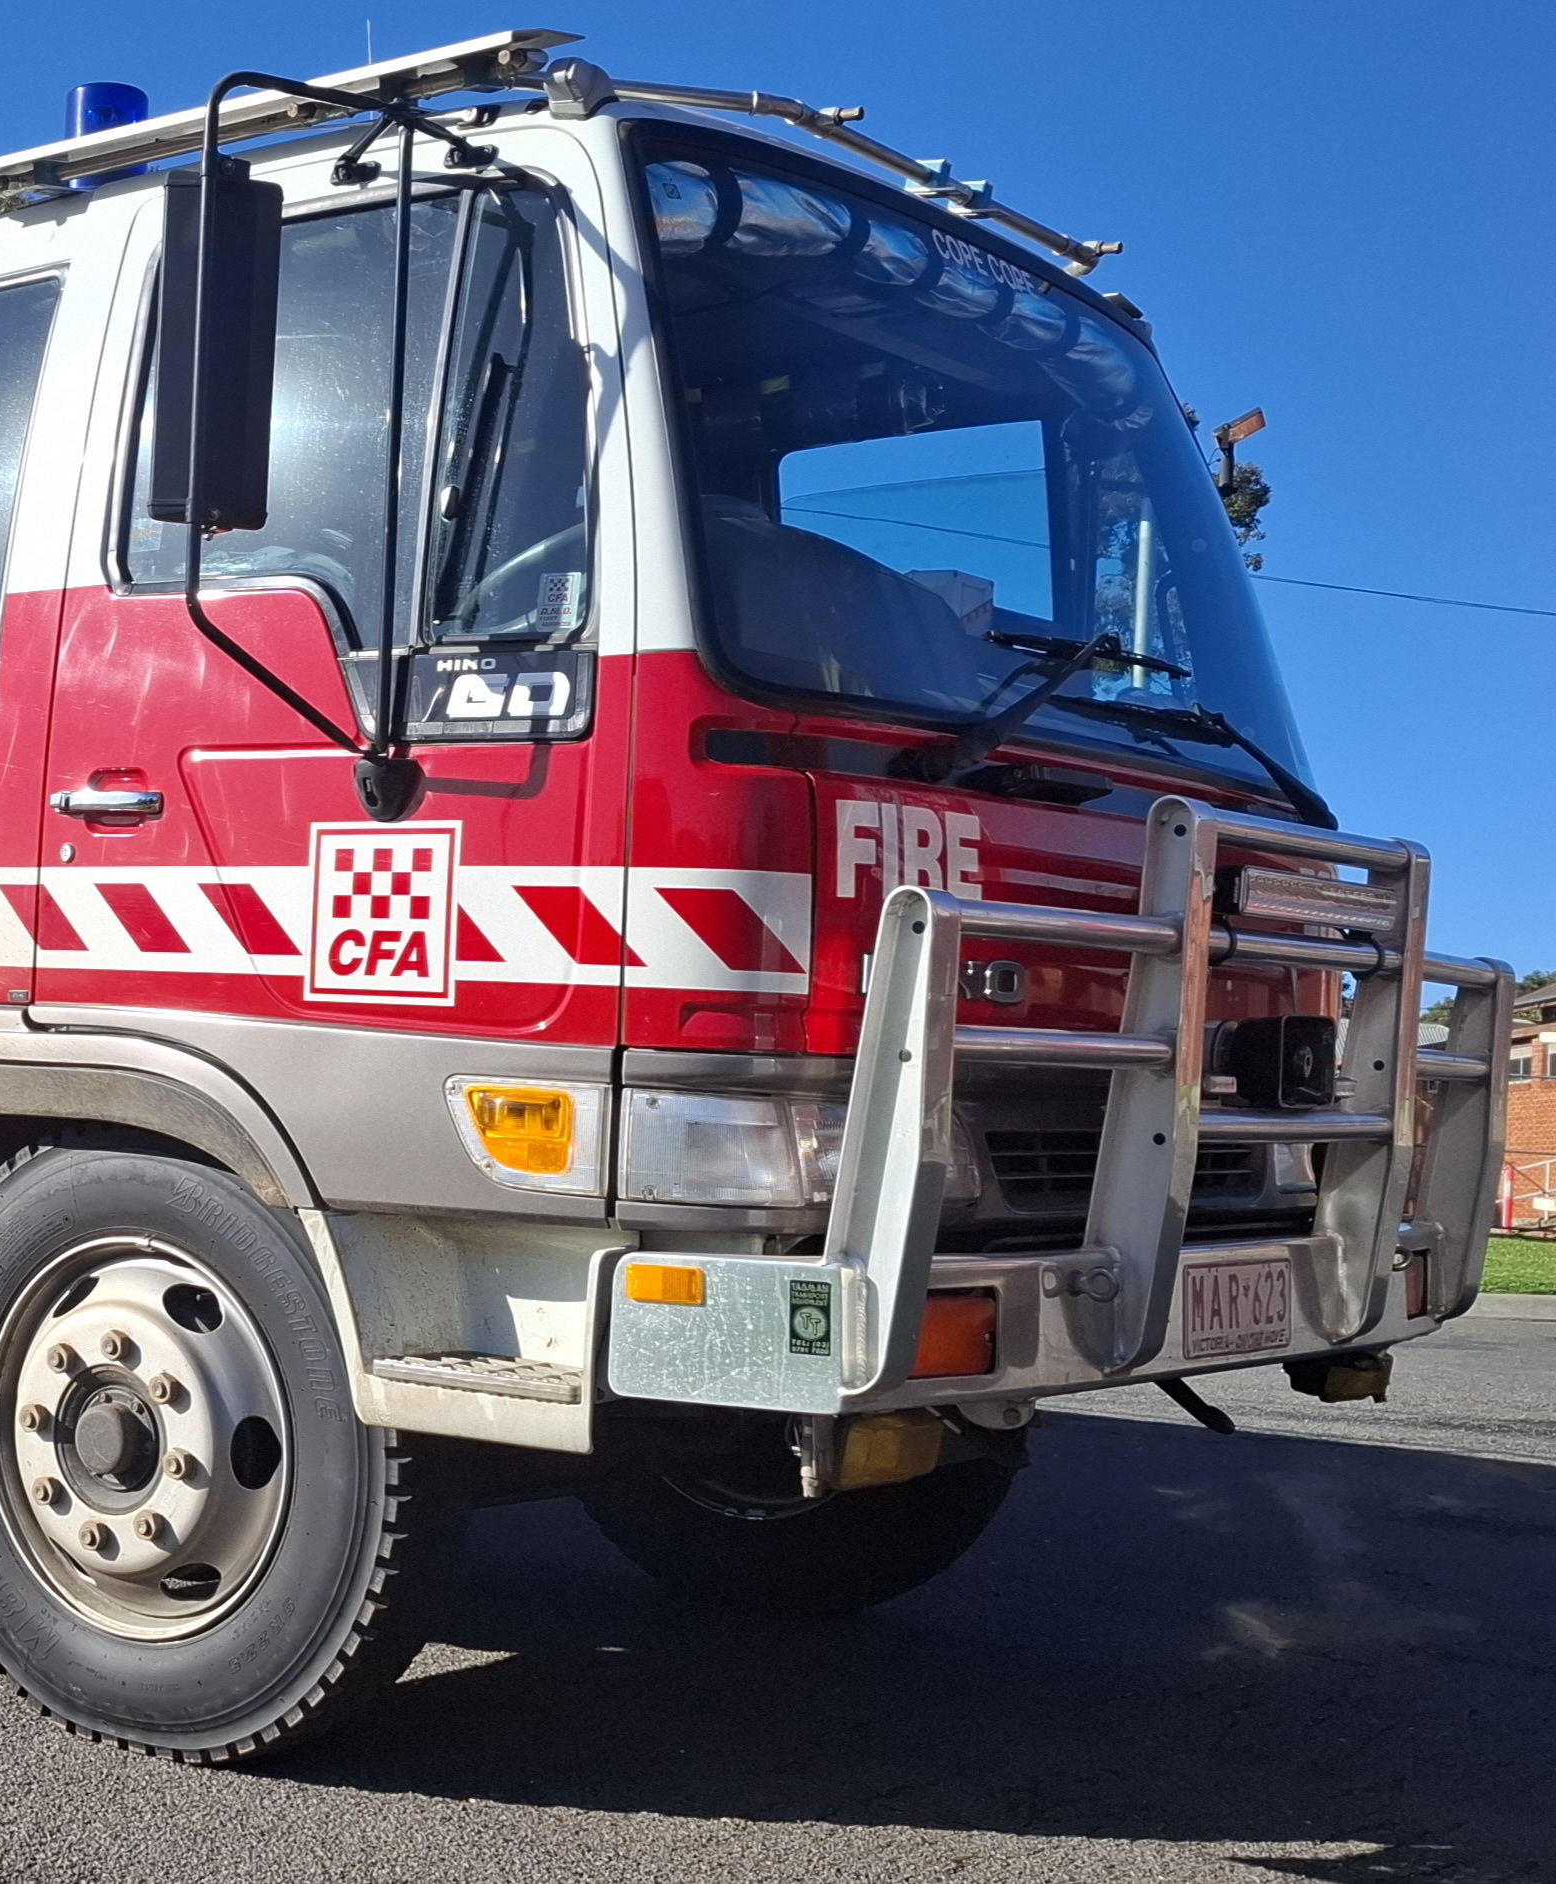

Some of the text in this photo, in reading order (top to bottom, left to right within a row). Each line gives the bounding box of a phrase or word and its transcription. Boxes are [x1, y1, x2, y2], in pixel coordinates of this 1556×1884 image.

[932, 229, 1039, 299] COPE COPE
[548, 593, 568, 602] CFA
[437, 658, 496, 671] HINO
[836, 799, 982, 900] FIRE
[328, 928, 430, 977] CFA
[166, 1176, 343, 1421] BRIDGESTONE
[800, 1312, 821, 1336] TT
[1191, 1268, 1286, 1331] MAR 623
